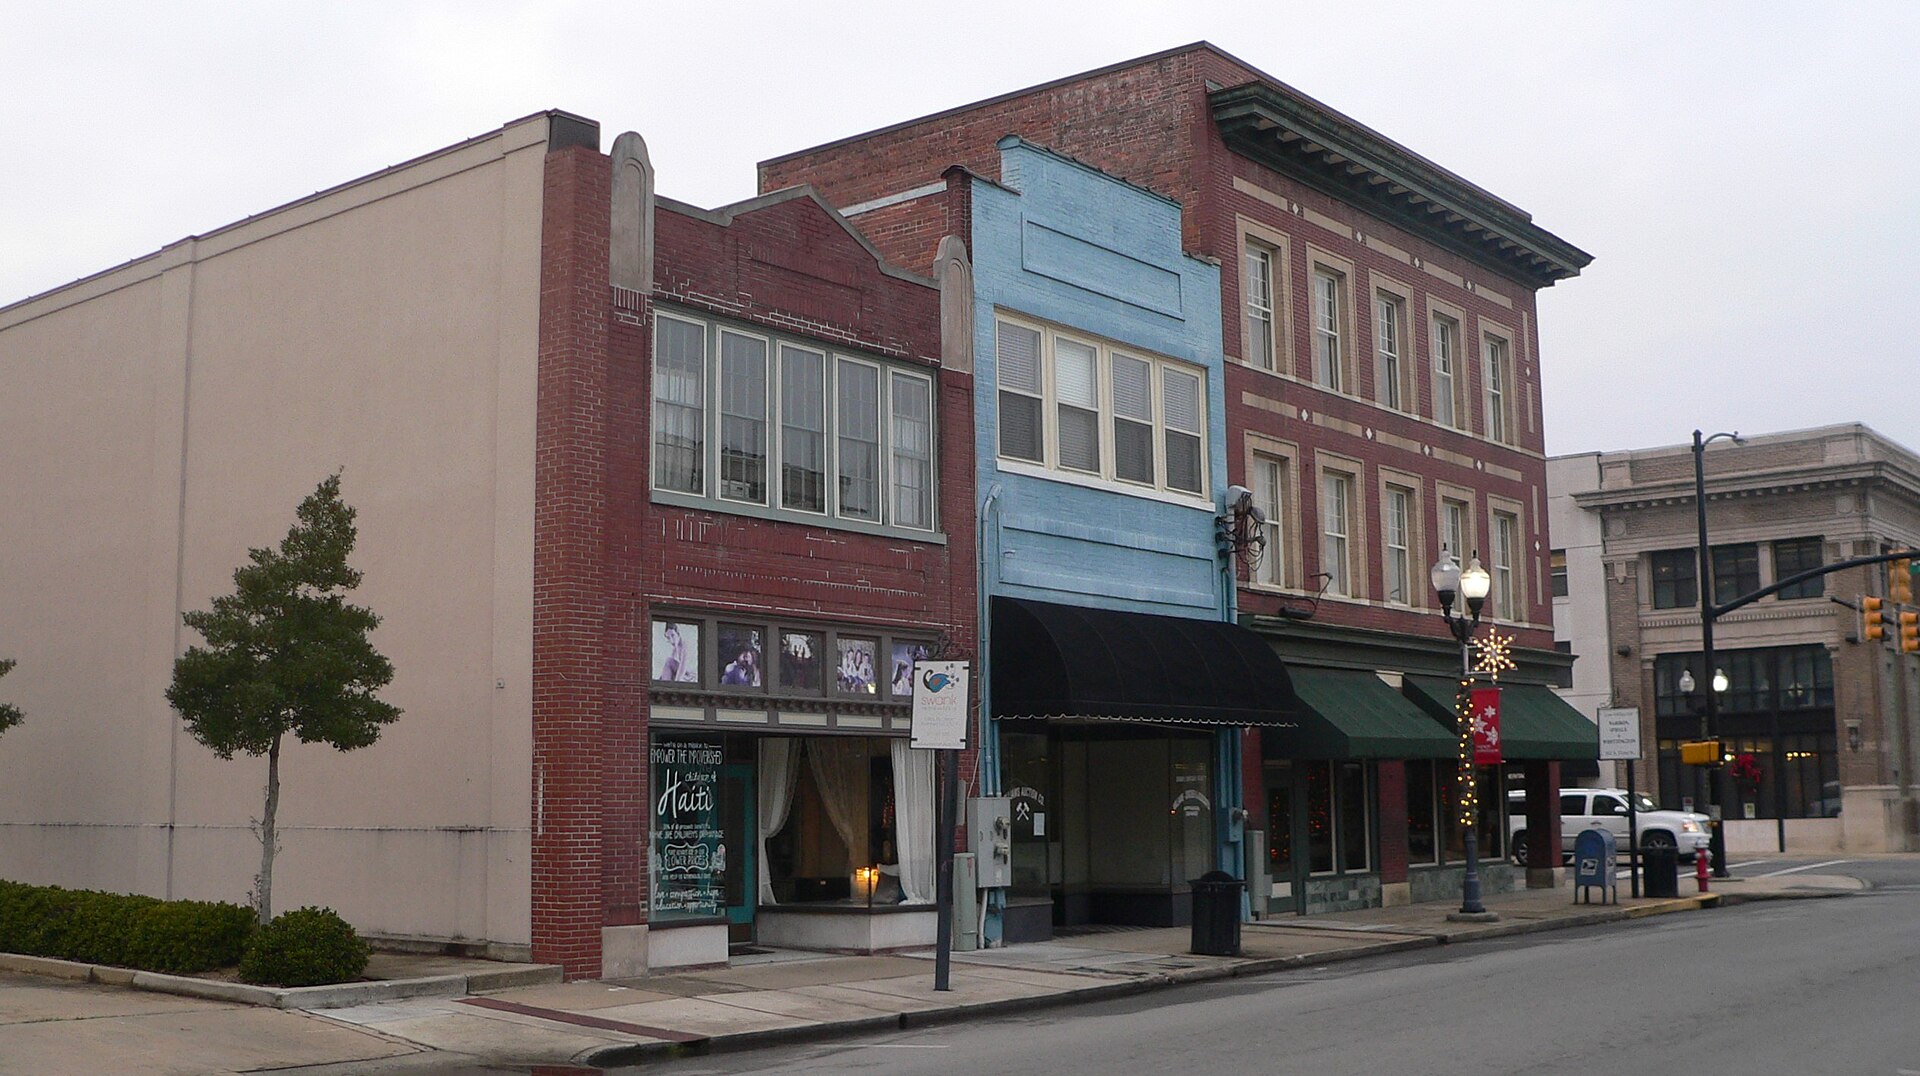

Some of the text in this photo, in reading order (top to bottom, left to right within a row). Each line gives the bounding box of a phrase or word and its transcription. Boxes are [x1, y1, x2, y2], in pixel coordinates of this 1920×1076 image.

[921, 694, 958, 706] swank
[650, 748, 676, 764] EMPOWER
[677, 749, 688, 764] THE
[658, 768, 714, 818] Haiti
